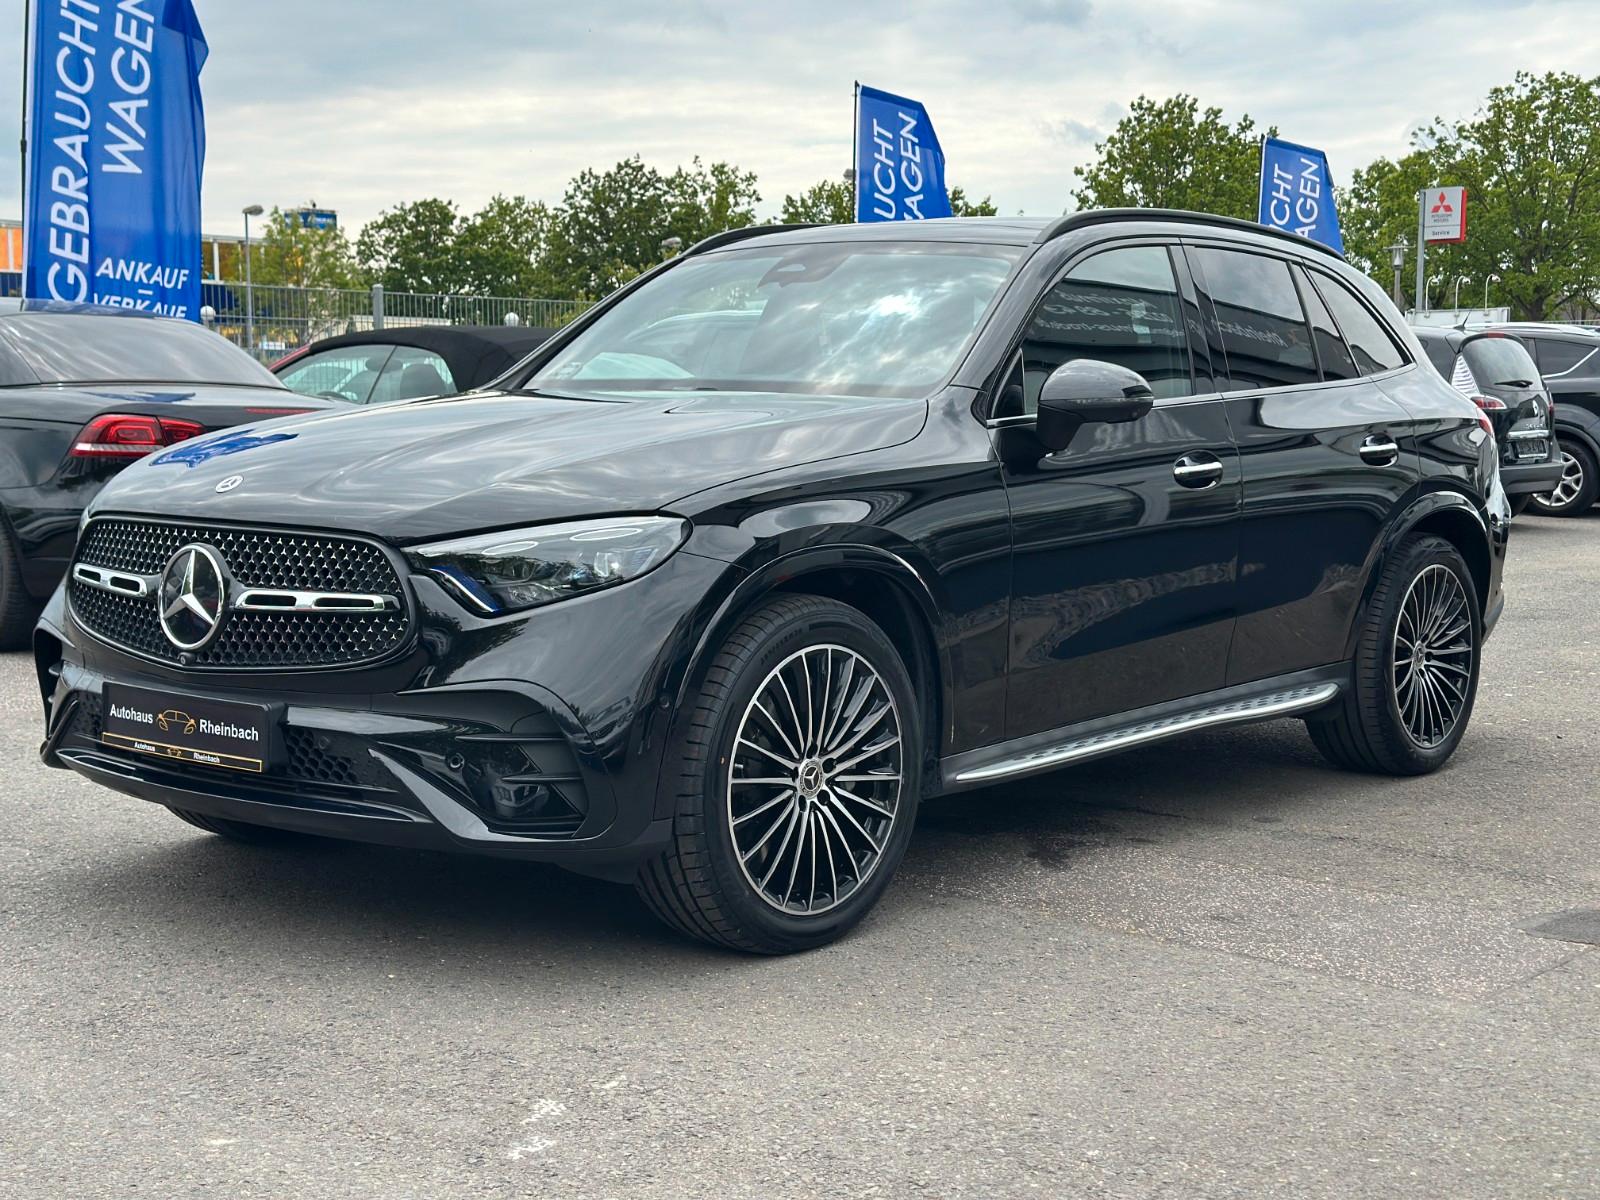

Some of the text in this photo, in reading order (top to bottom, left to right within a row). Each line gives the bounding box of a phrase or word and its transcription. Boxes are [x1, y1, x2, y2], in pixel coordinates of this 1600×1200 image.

[898, 111, 925, 220] AGEN
[1269, 163, 1293, 232] CHT
[96, 257, 189, 290] ANKAUF
[110, 704, 258, 741] Autohaus Rheinbach
[134, 742, 220, 764] Autohaus Rheinbach
